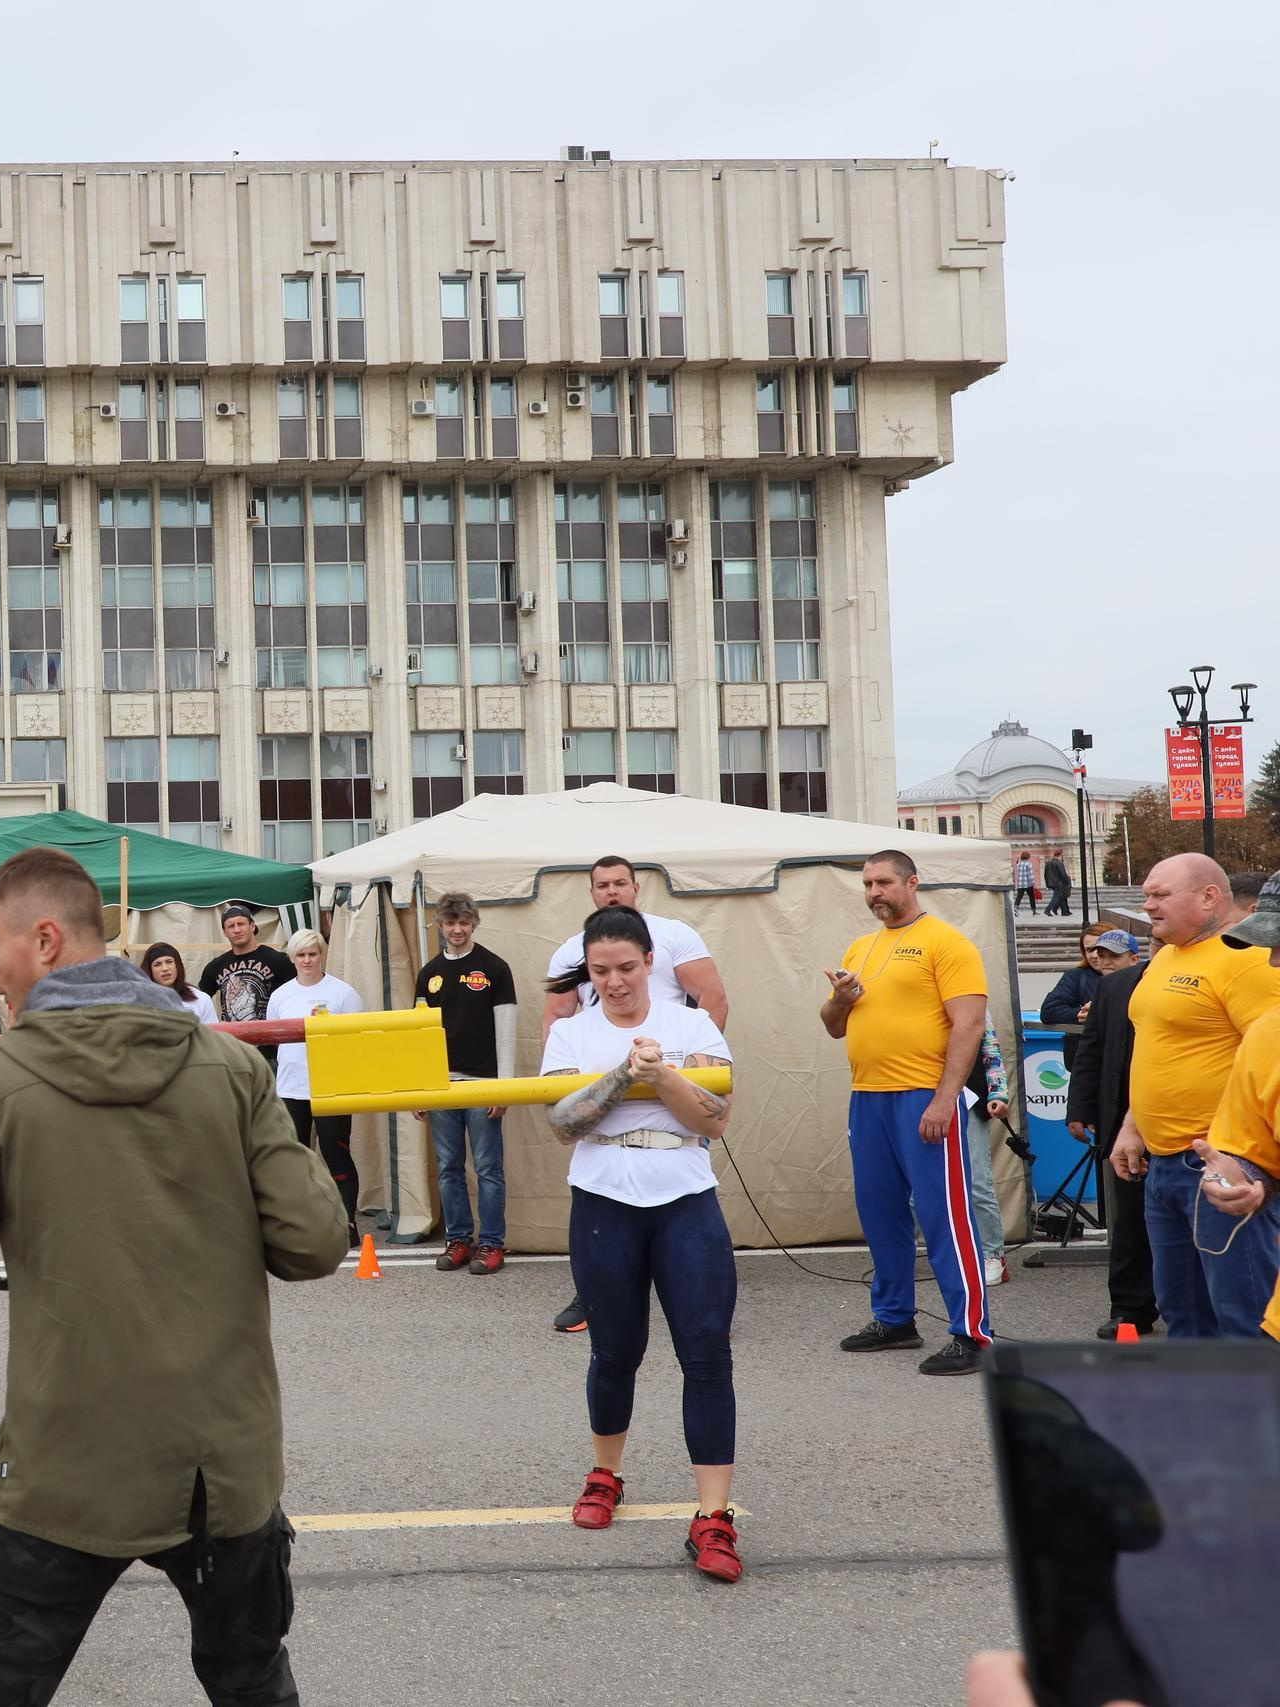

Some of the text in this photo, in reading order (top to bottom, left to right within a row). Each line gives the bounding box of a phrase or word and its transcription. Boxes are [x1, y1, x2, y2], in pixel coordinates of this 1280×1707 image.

[1173, 762, 1199, 770] туляки!
[895, 948, 922, 956] СИЛА
[1169, 975, 1199, 988] СИЛА
